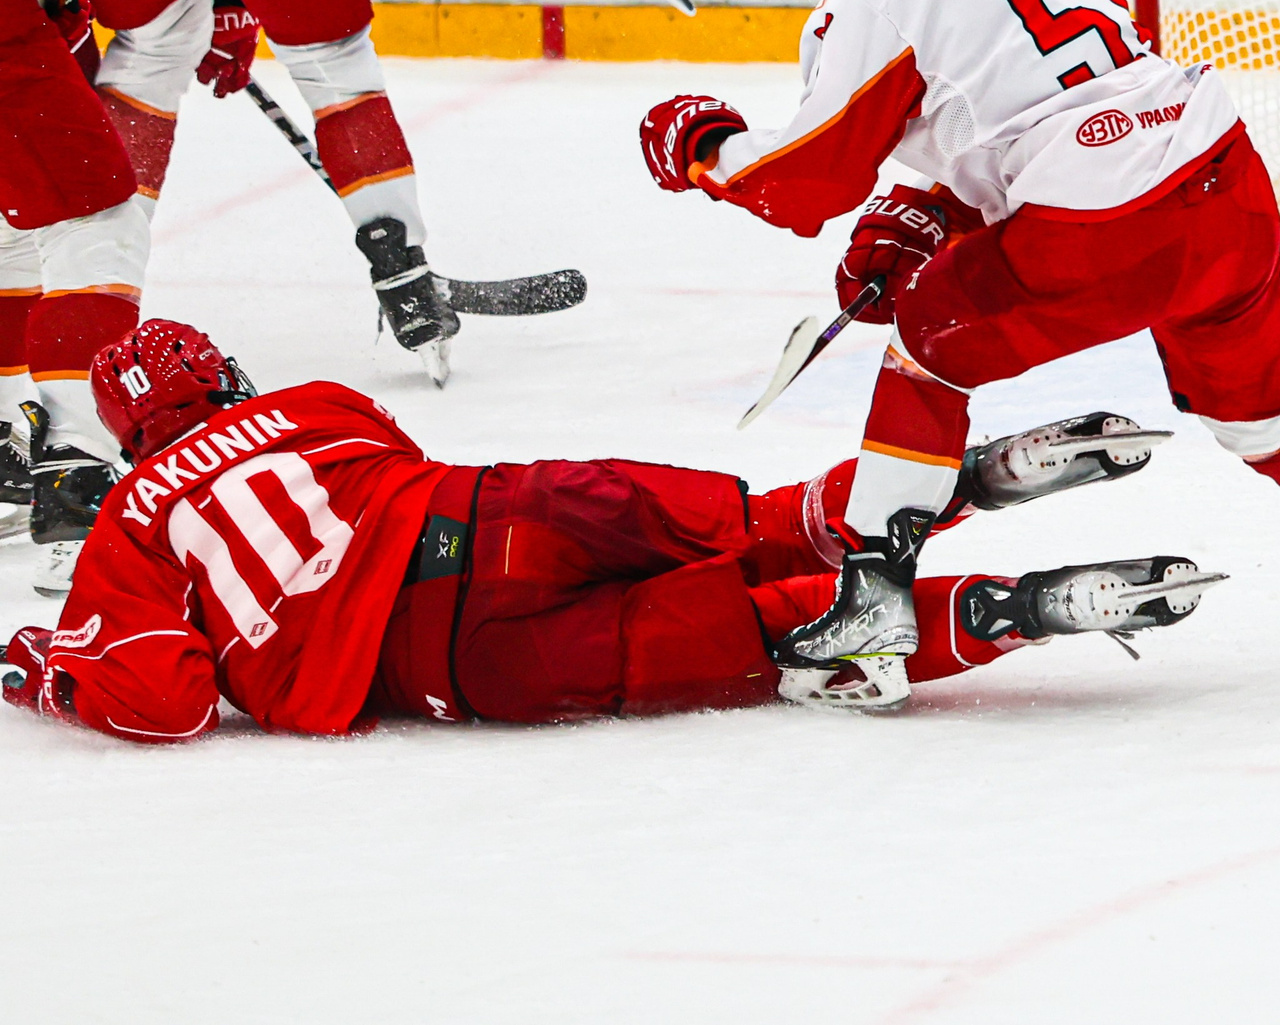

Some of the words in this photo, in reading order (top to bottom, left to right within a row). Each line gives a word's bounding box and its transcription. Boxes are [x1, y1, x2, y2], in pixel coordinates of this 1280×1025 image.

[1079, 111, 1131, 146] УЗТМ
[866, 197, 945, 246] AUER
[119, 364, 153, 401] 10
[121, 408, 299, 528] YAKUNIN
[166, 451, 355, 650] 10
